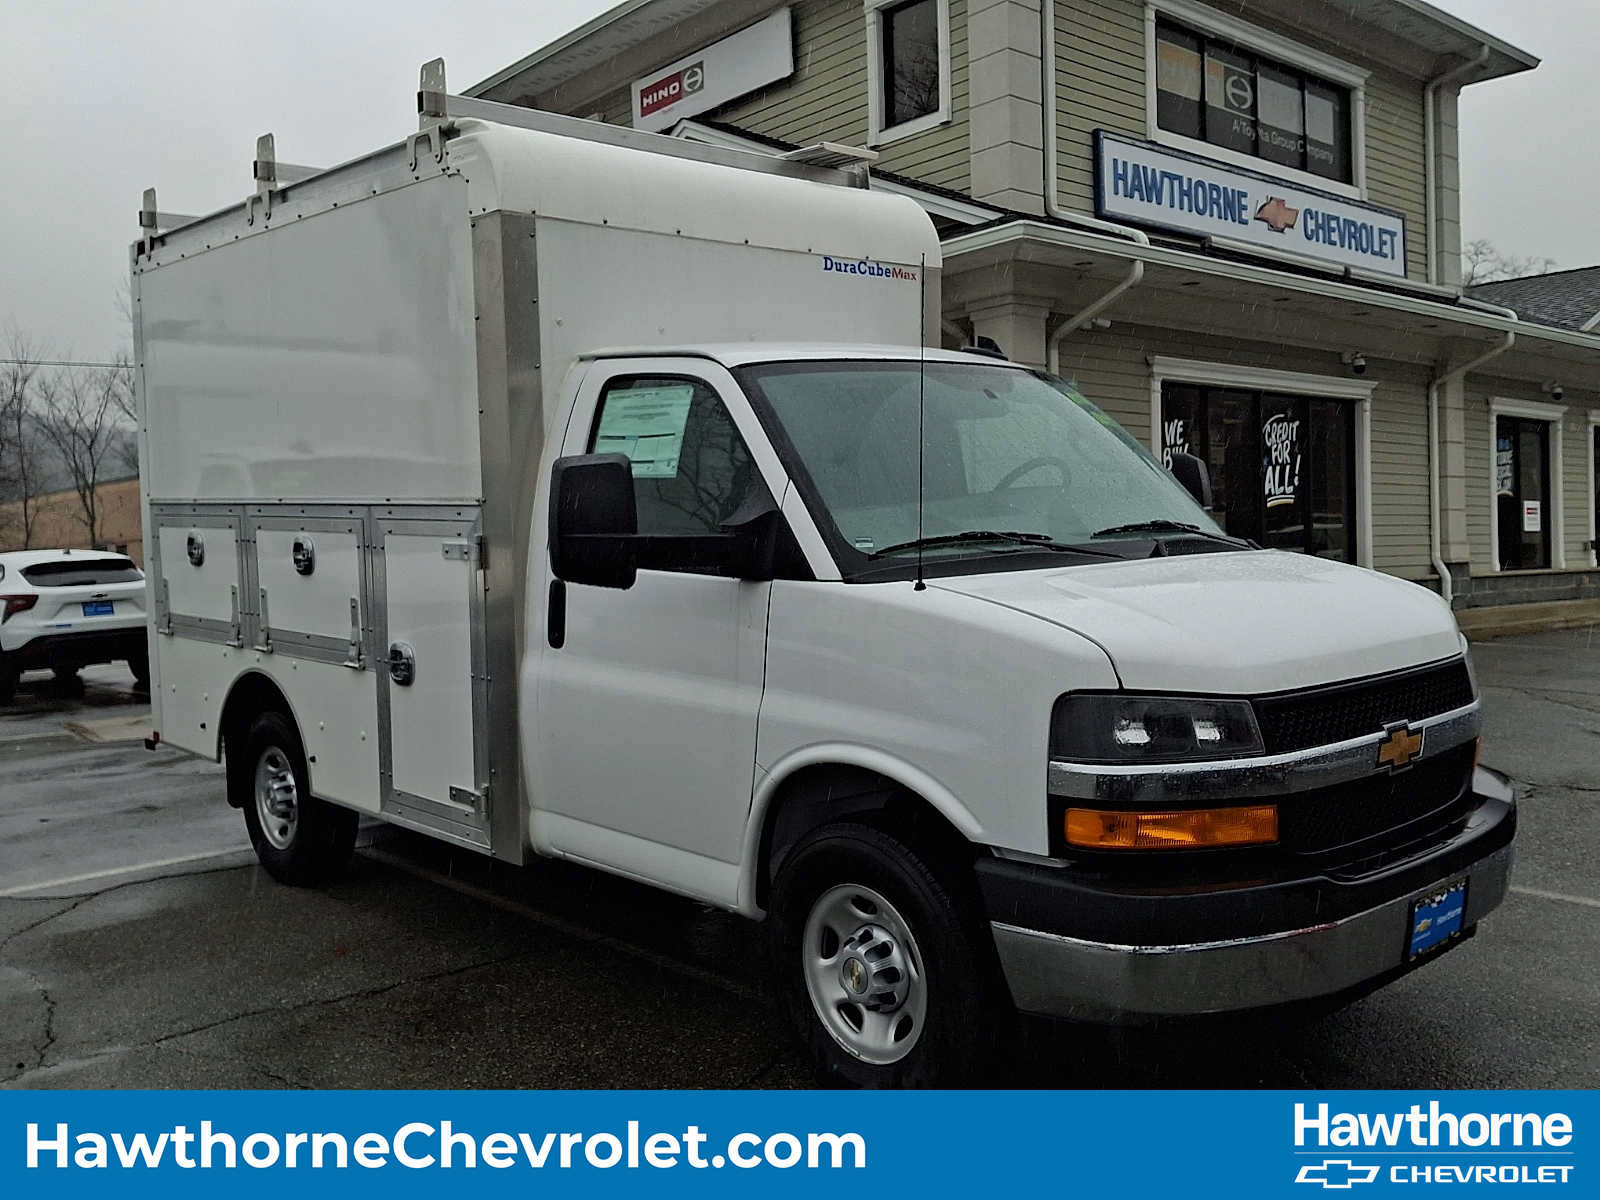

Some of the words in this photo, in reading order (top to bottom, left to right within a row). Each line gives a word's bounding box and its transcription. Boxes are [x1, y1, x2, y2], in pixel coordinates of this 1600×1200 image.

[642, 82, 680, 107] HINO
[1241, 120, 1270, 143] Toyta
[1271, 131, 1296, 152] Group
[1297, 140, 1334, 164] Cmpany
[1112, 158, 1249, 225] HAWTHORNE
[1303, 208, 1398, 260] CHEVROLET
[1164, 419, 1184, 446] WE
[1264, 420, 1300, 447] CREDIT
[1271, 440, 1291, 465] FOR
[1265, 454, 1301, 495] ALL!
